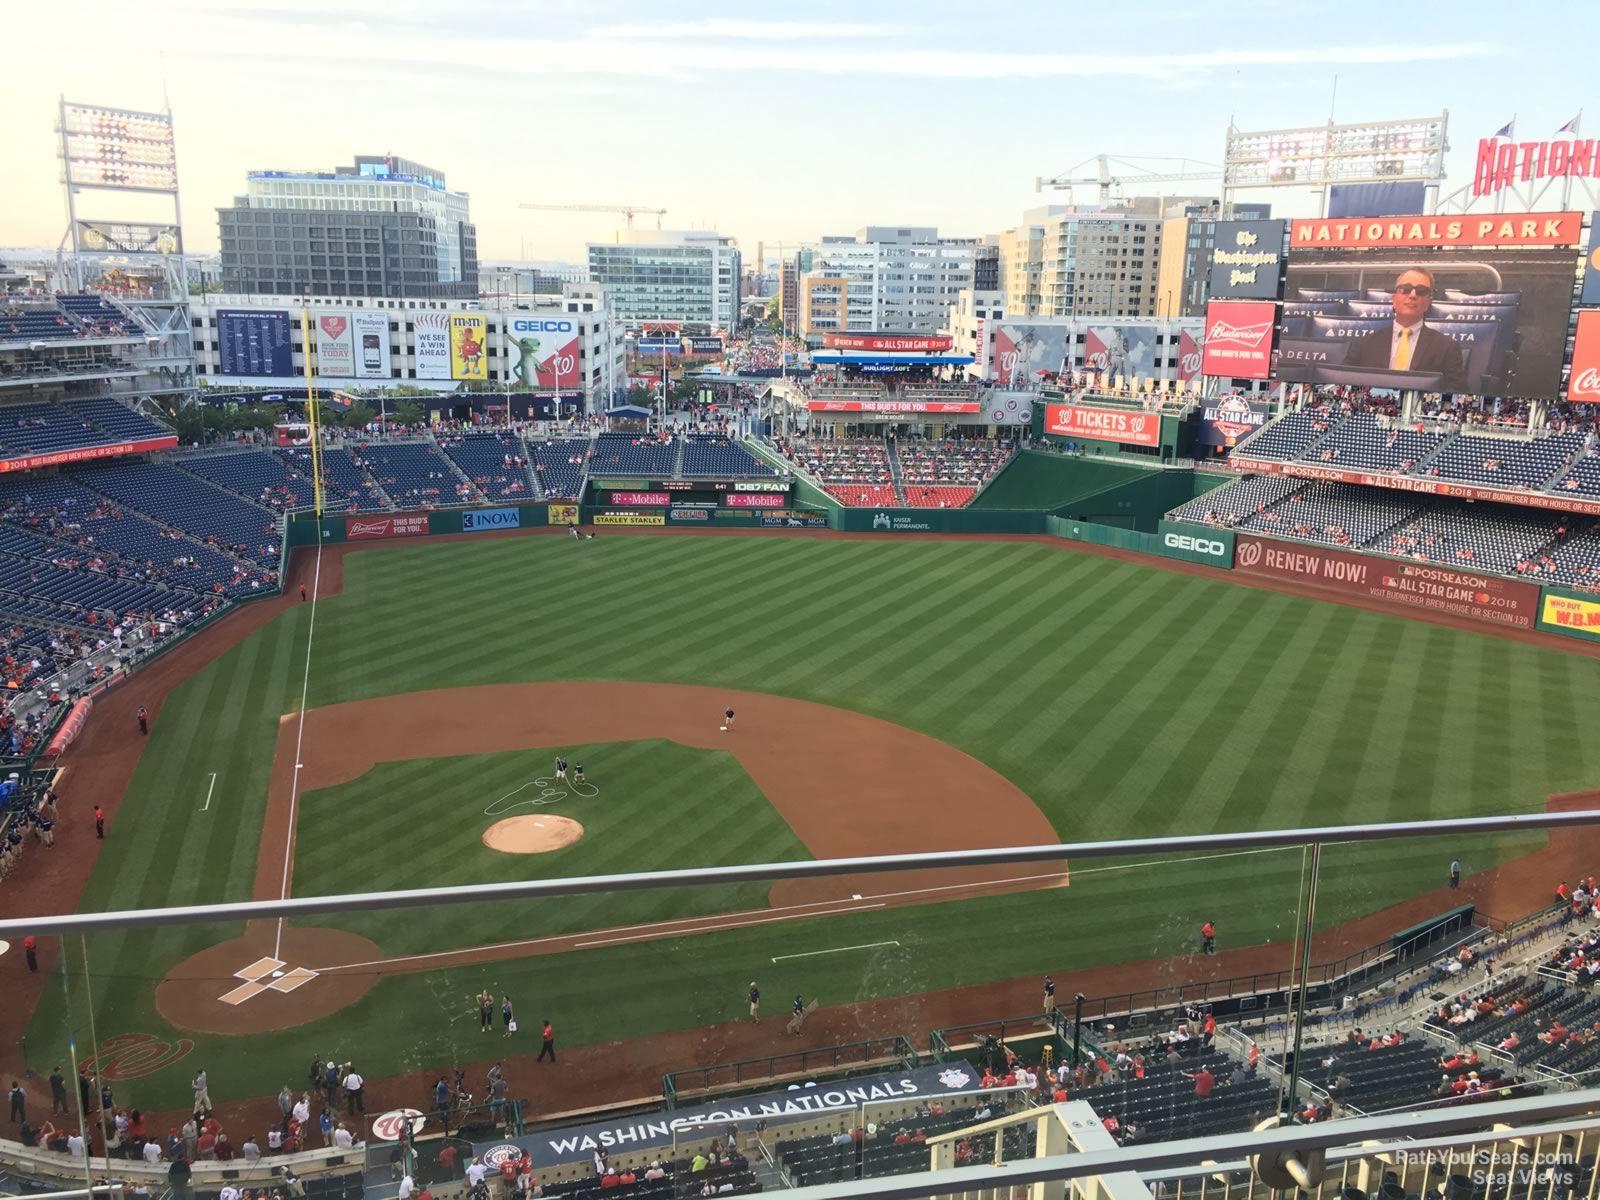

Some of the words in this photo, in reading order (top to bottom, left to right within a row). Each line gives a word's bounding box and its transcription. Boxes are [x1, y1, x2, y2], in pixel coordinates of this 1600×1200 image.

[1236, 230, 1258, 247] The
[1299, 220, 1463, 242] NATIONALS
[1477, 219, 1563, 240] PARK
[1213, 248, 1278, 268] Washington
[1230, 270, 1256, 288] Post
[514, 320, 572, 333] GEICO
[1211, 326, 1265, 341] Budweiser
[884, 340, 896, 349] ALL
[897, 340, 913, 349] STAR
[913, 340, 929, 348] GAME
[1286, 350, 1327, 361] DELTA
[861, 402, 876, 411] THIS
[877, 403, 896, 411] BUD'S
[898, 403, 911, 411] FOR
[1076, 411, 1126, 430] TICKETS
[1204, 409, 1219, 420] ALL
[1220, 410, 1240, 423] STAR
[1241, 412, 1265, 425] GAME
[1291, 467, 1343, 480] POSTSEASON
[1375, 477, 1392, 488] ALL
[1391, 478, 1412, 491] STAR
[1414, 482, 1437, 493] GAME
[1450, 489, 1472, 497] 2018
[1477, 491, 1492, 500] VISIT
[1492, 493, 1529, 504] BUDWEISER
[1529, 497, 1549, 507] BREW
[1550, 499, 1571, 511] HOUSE
[409, 517, 428, 525] BUD'S
[477, 513, 518, 526] INOVA
[1164, 533, 1225, 556] GEICO
[1265, 548, 1319, 575] RENEW
[1323, 558, 1368, 584] NOW!
[1414, 567, 1487, 589] POSTSEASON
[1399, 578, 1418, 592] ALL
[1418, 583, 1444, 596] STAR
[1446, 586, 1474, 603] GAME
[1490, 597, 1517, 609] 2018
[1369, 587, 1386, 597] VISIT
[1386, 590, 1425, 604] BUDWEISER
[1425, 596, 1446, 609] BREW
[1446, 602, 1470, 615] HOUSE
[1471, 607, 1482, 616] OR
[1482, 608, 1516, 623] SECTION
[1514, 614, 1529, 625] 139
[758, 1079, 918, 1116] NATIONALS
